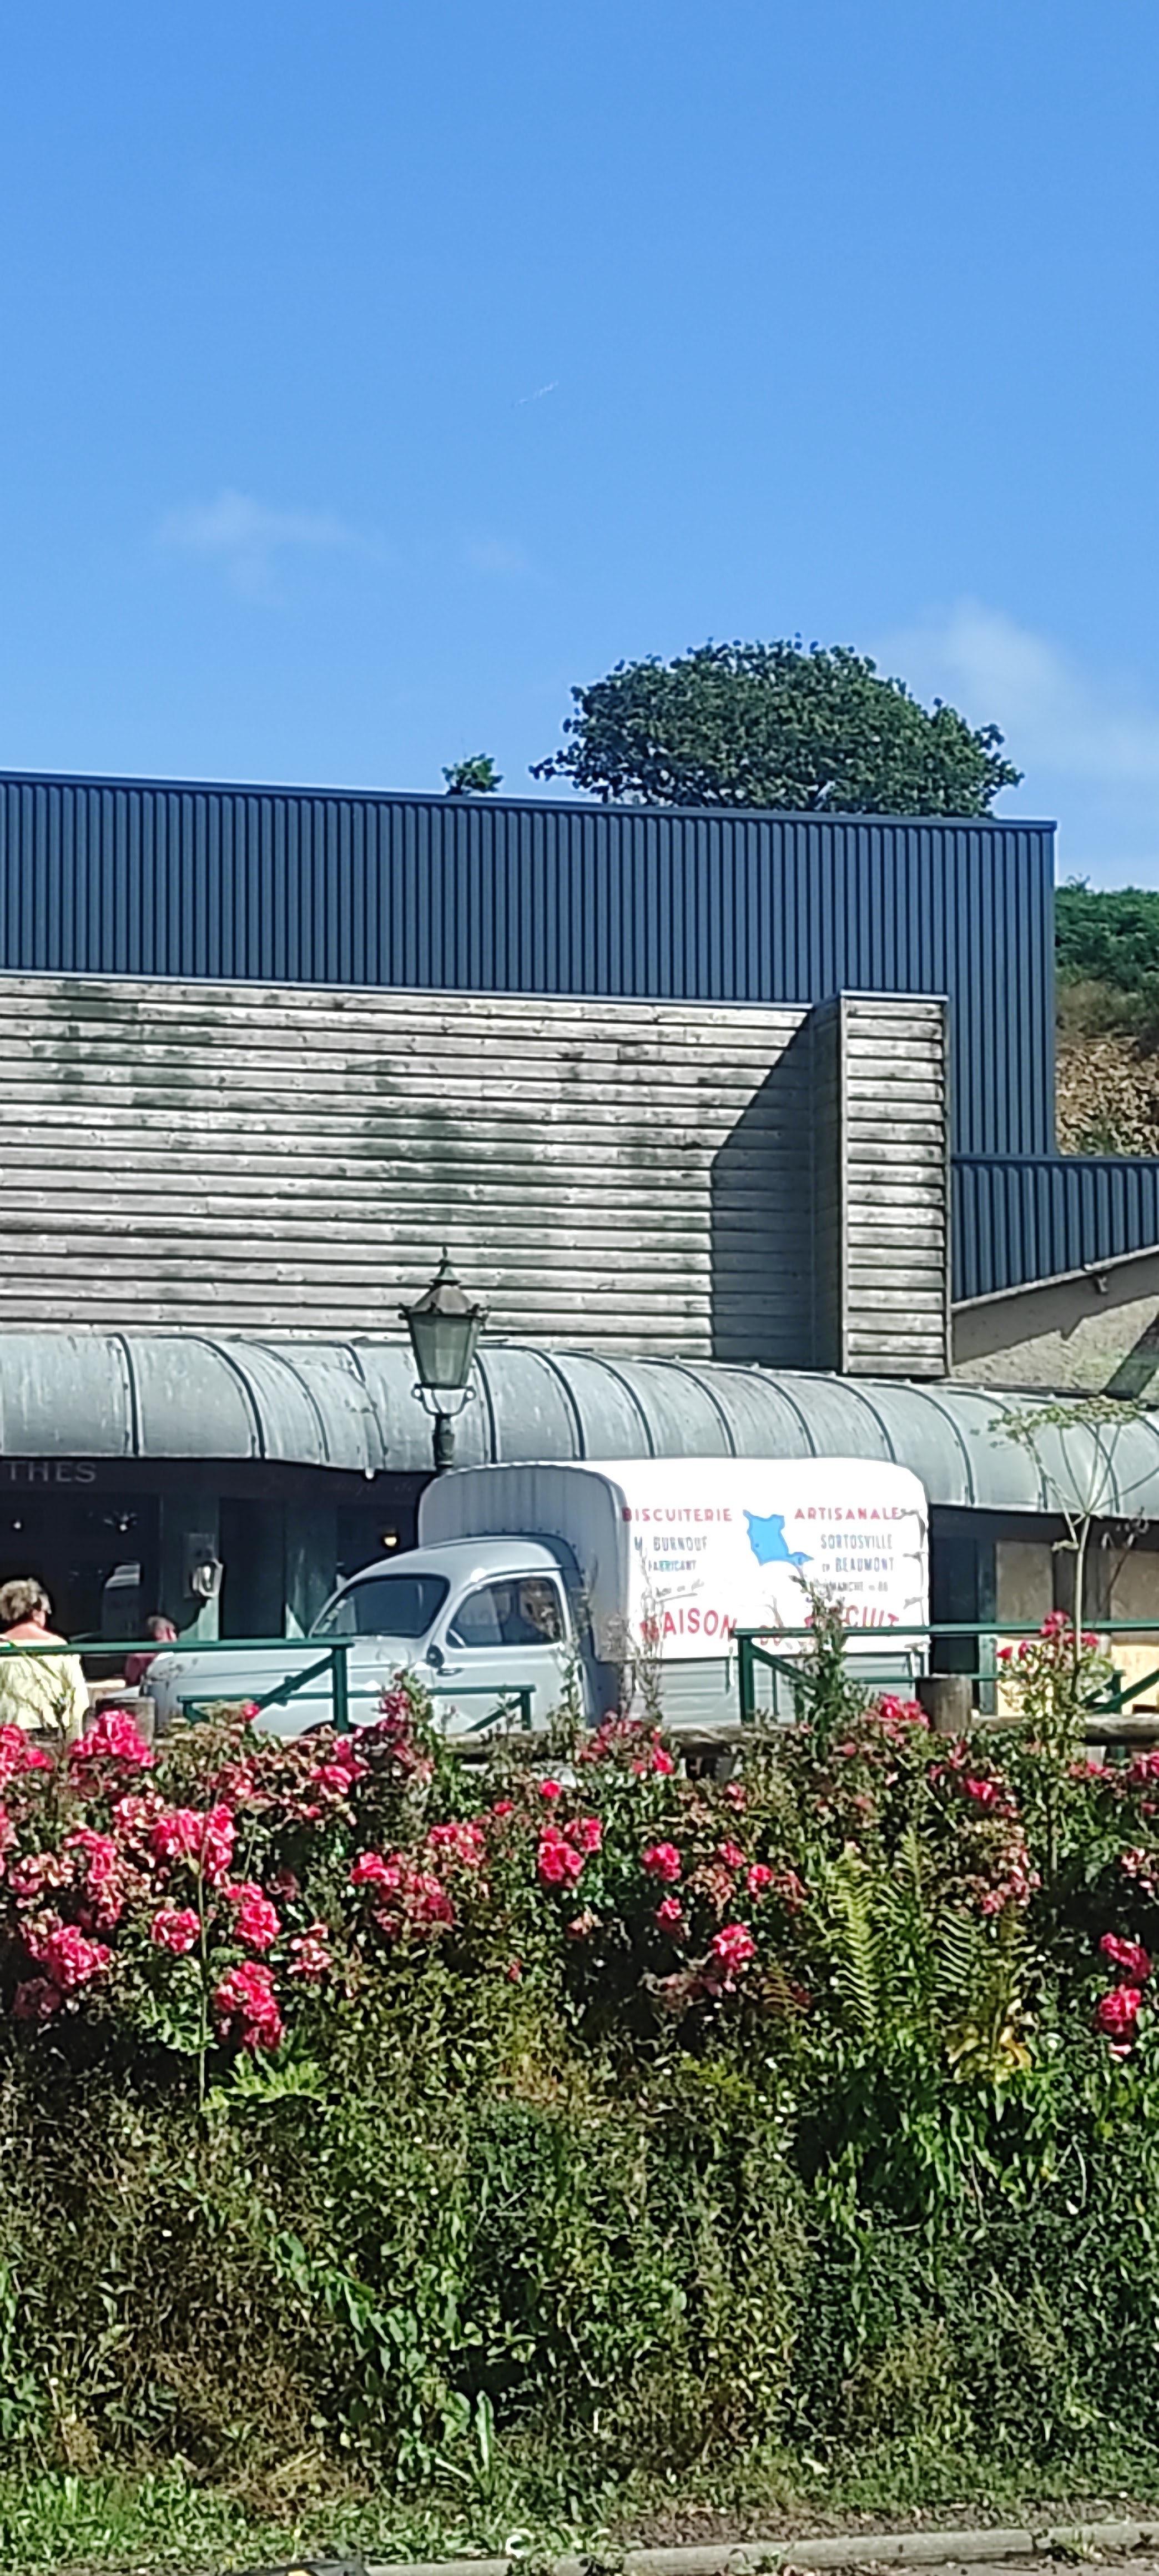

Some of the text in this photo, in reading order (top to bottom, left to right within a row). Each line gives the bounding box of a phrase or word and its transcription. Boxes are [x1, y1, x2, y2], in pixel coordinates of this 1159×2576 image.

[622, 1507, 899, 1522] BISCUITERIE ARTISANALE
[820, 1534, 893, 1549] SORTOSVILLE
[835, 1557, 894, 1572] BEAUMONT
